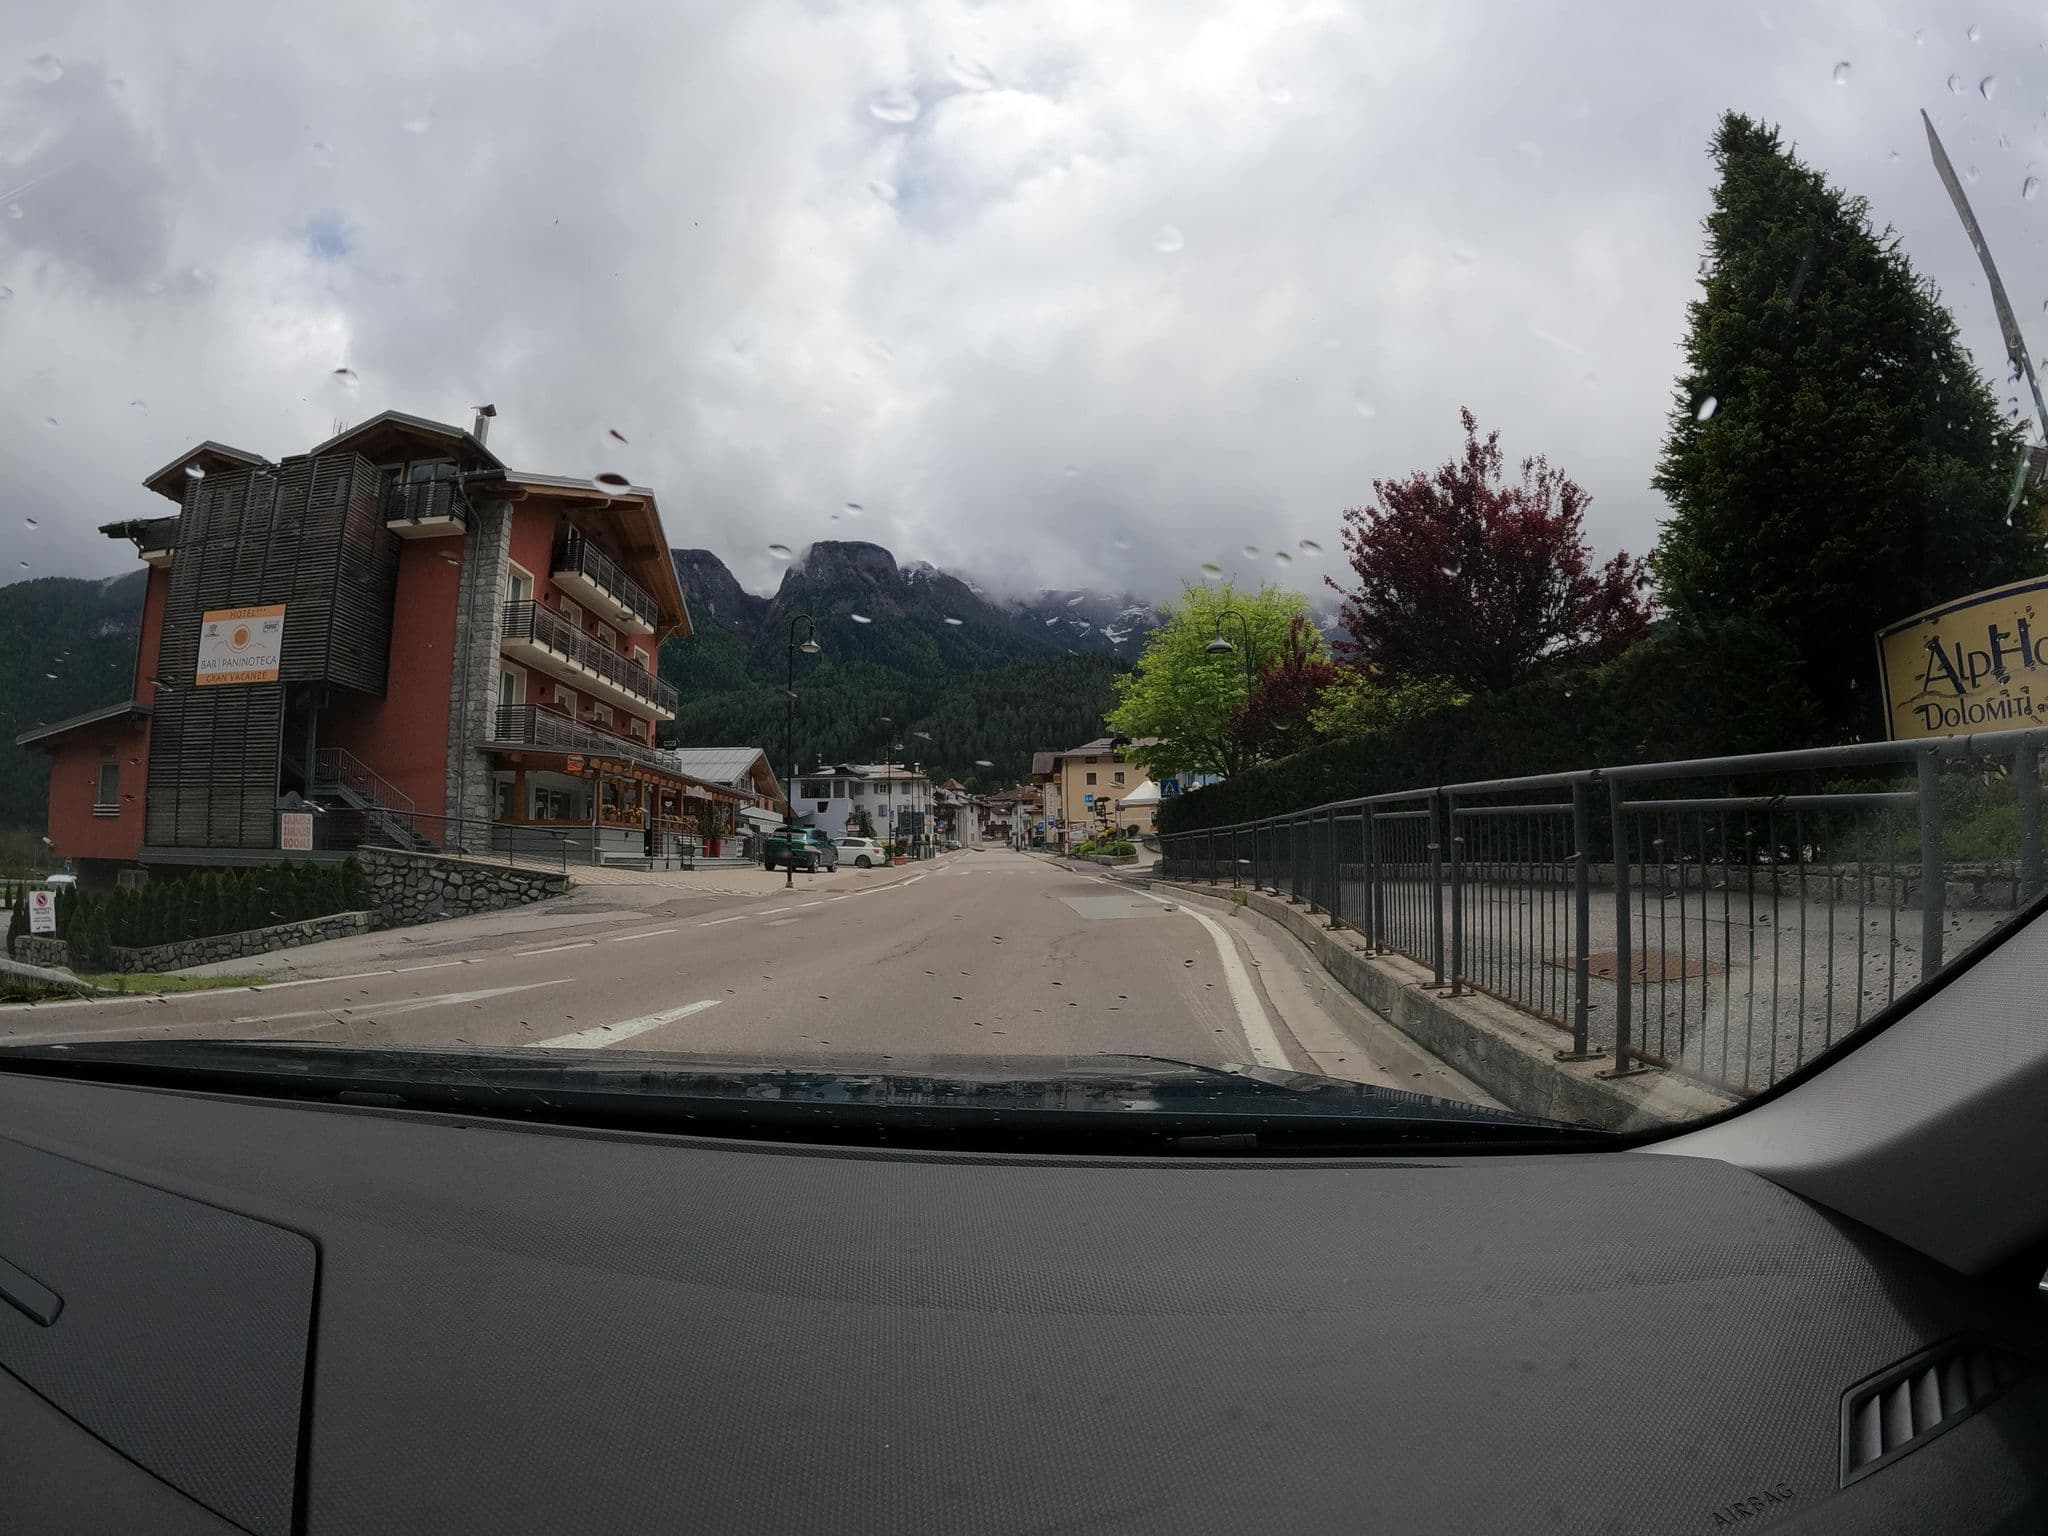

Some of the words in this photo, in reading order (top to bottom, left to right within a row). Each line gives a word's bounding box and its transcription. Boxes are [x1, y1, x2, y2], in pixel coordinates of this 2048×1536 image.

[230, 610, 255, 619] HOTEL
[201, 659, 217, 669] BAR
[222, 655, 277, 667] PANINOTECA
[230, 671, 268, 681] VACANZE
[1712, 1483, 1795, 1529] AIRBAG
